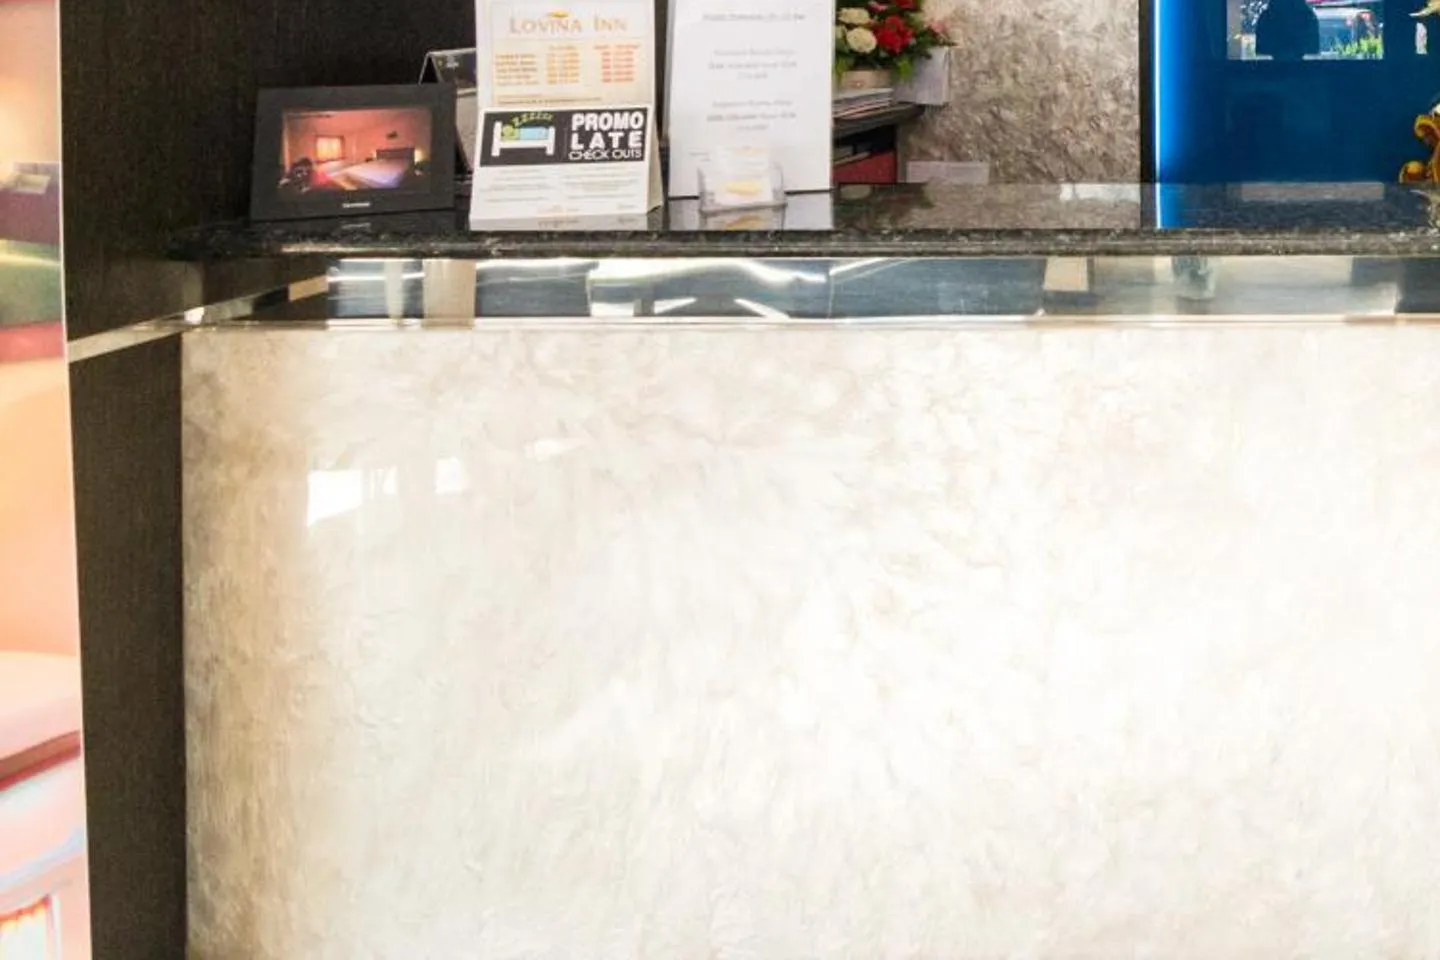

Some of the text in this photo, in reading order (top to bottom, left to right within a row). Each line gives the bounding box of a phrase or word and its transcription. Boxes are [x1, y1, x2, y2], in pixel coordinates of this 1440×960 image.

[509, 14, 629, 35] LOVINA INN
[571, 111, 645, 132] PROMO
[571, 130, 643, 151] LATE
[568, 149, 642, 161] CHECK OUTS
